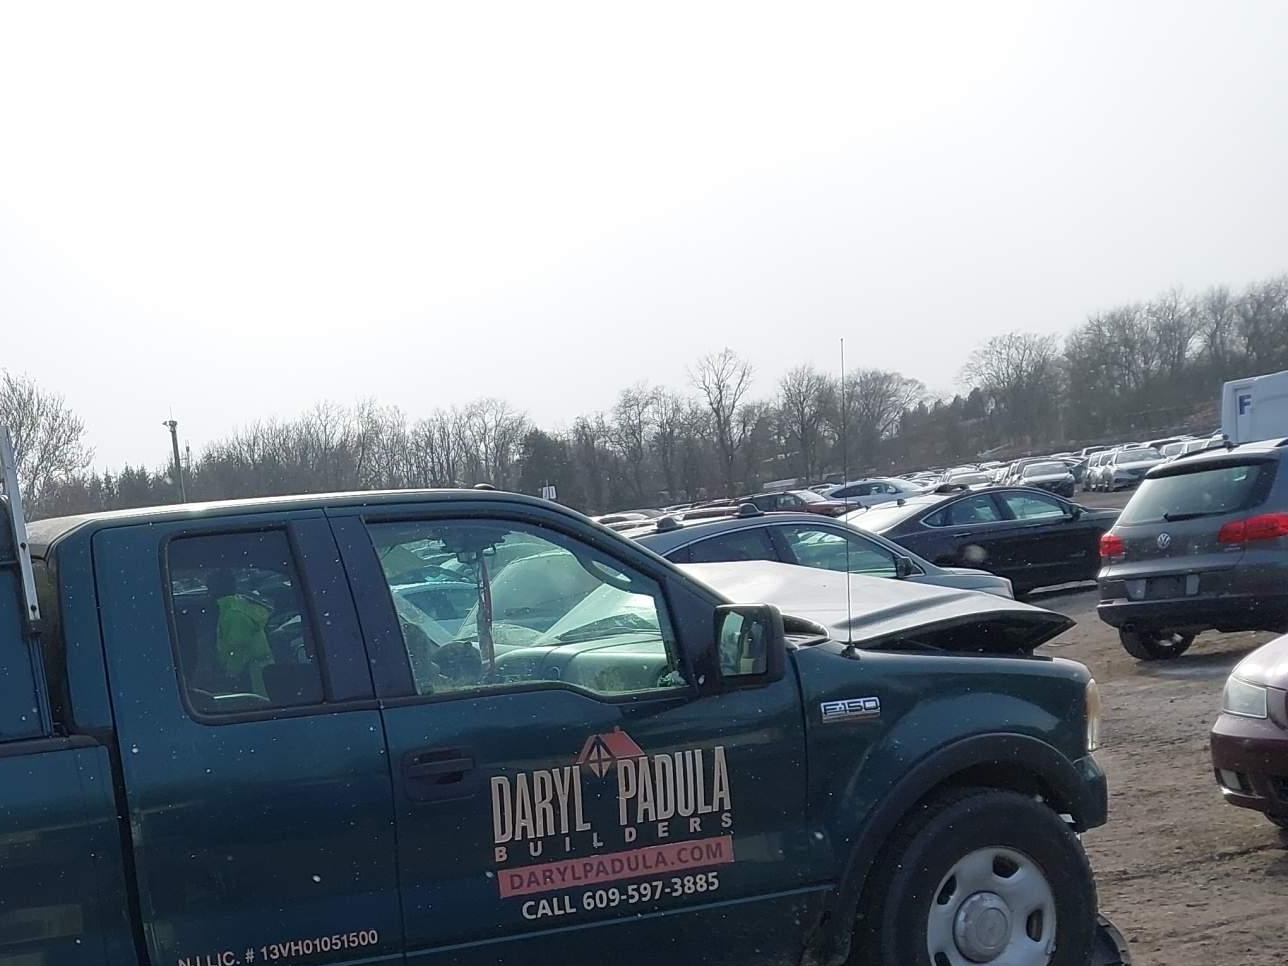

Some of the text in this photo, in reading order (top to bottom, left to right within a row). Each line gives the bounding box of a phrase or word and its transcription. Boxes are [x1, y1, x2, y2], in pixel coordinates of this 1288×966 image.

[491, 746, 732, 844] DARYL PADULA
[509, 842, 724, 891] DARYLPADULA.COM
[522, 871, 720, 920] CALL 609-597-3885
[245, 948, 255, 963] #
[260, 929, 379, 961] 13VH01051500
